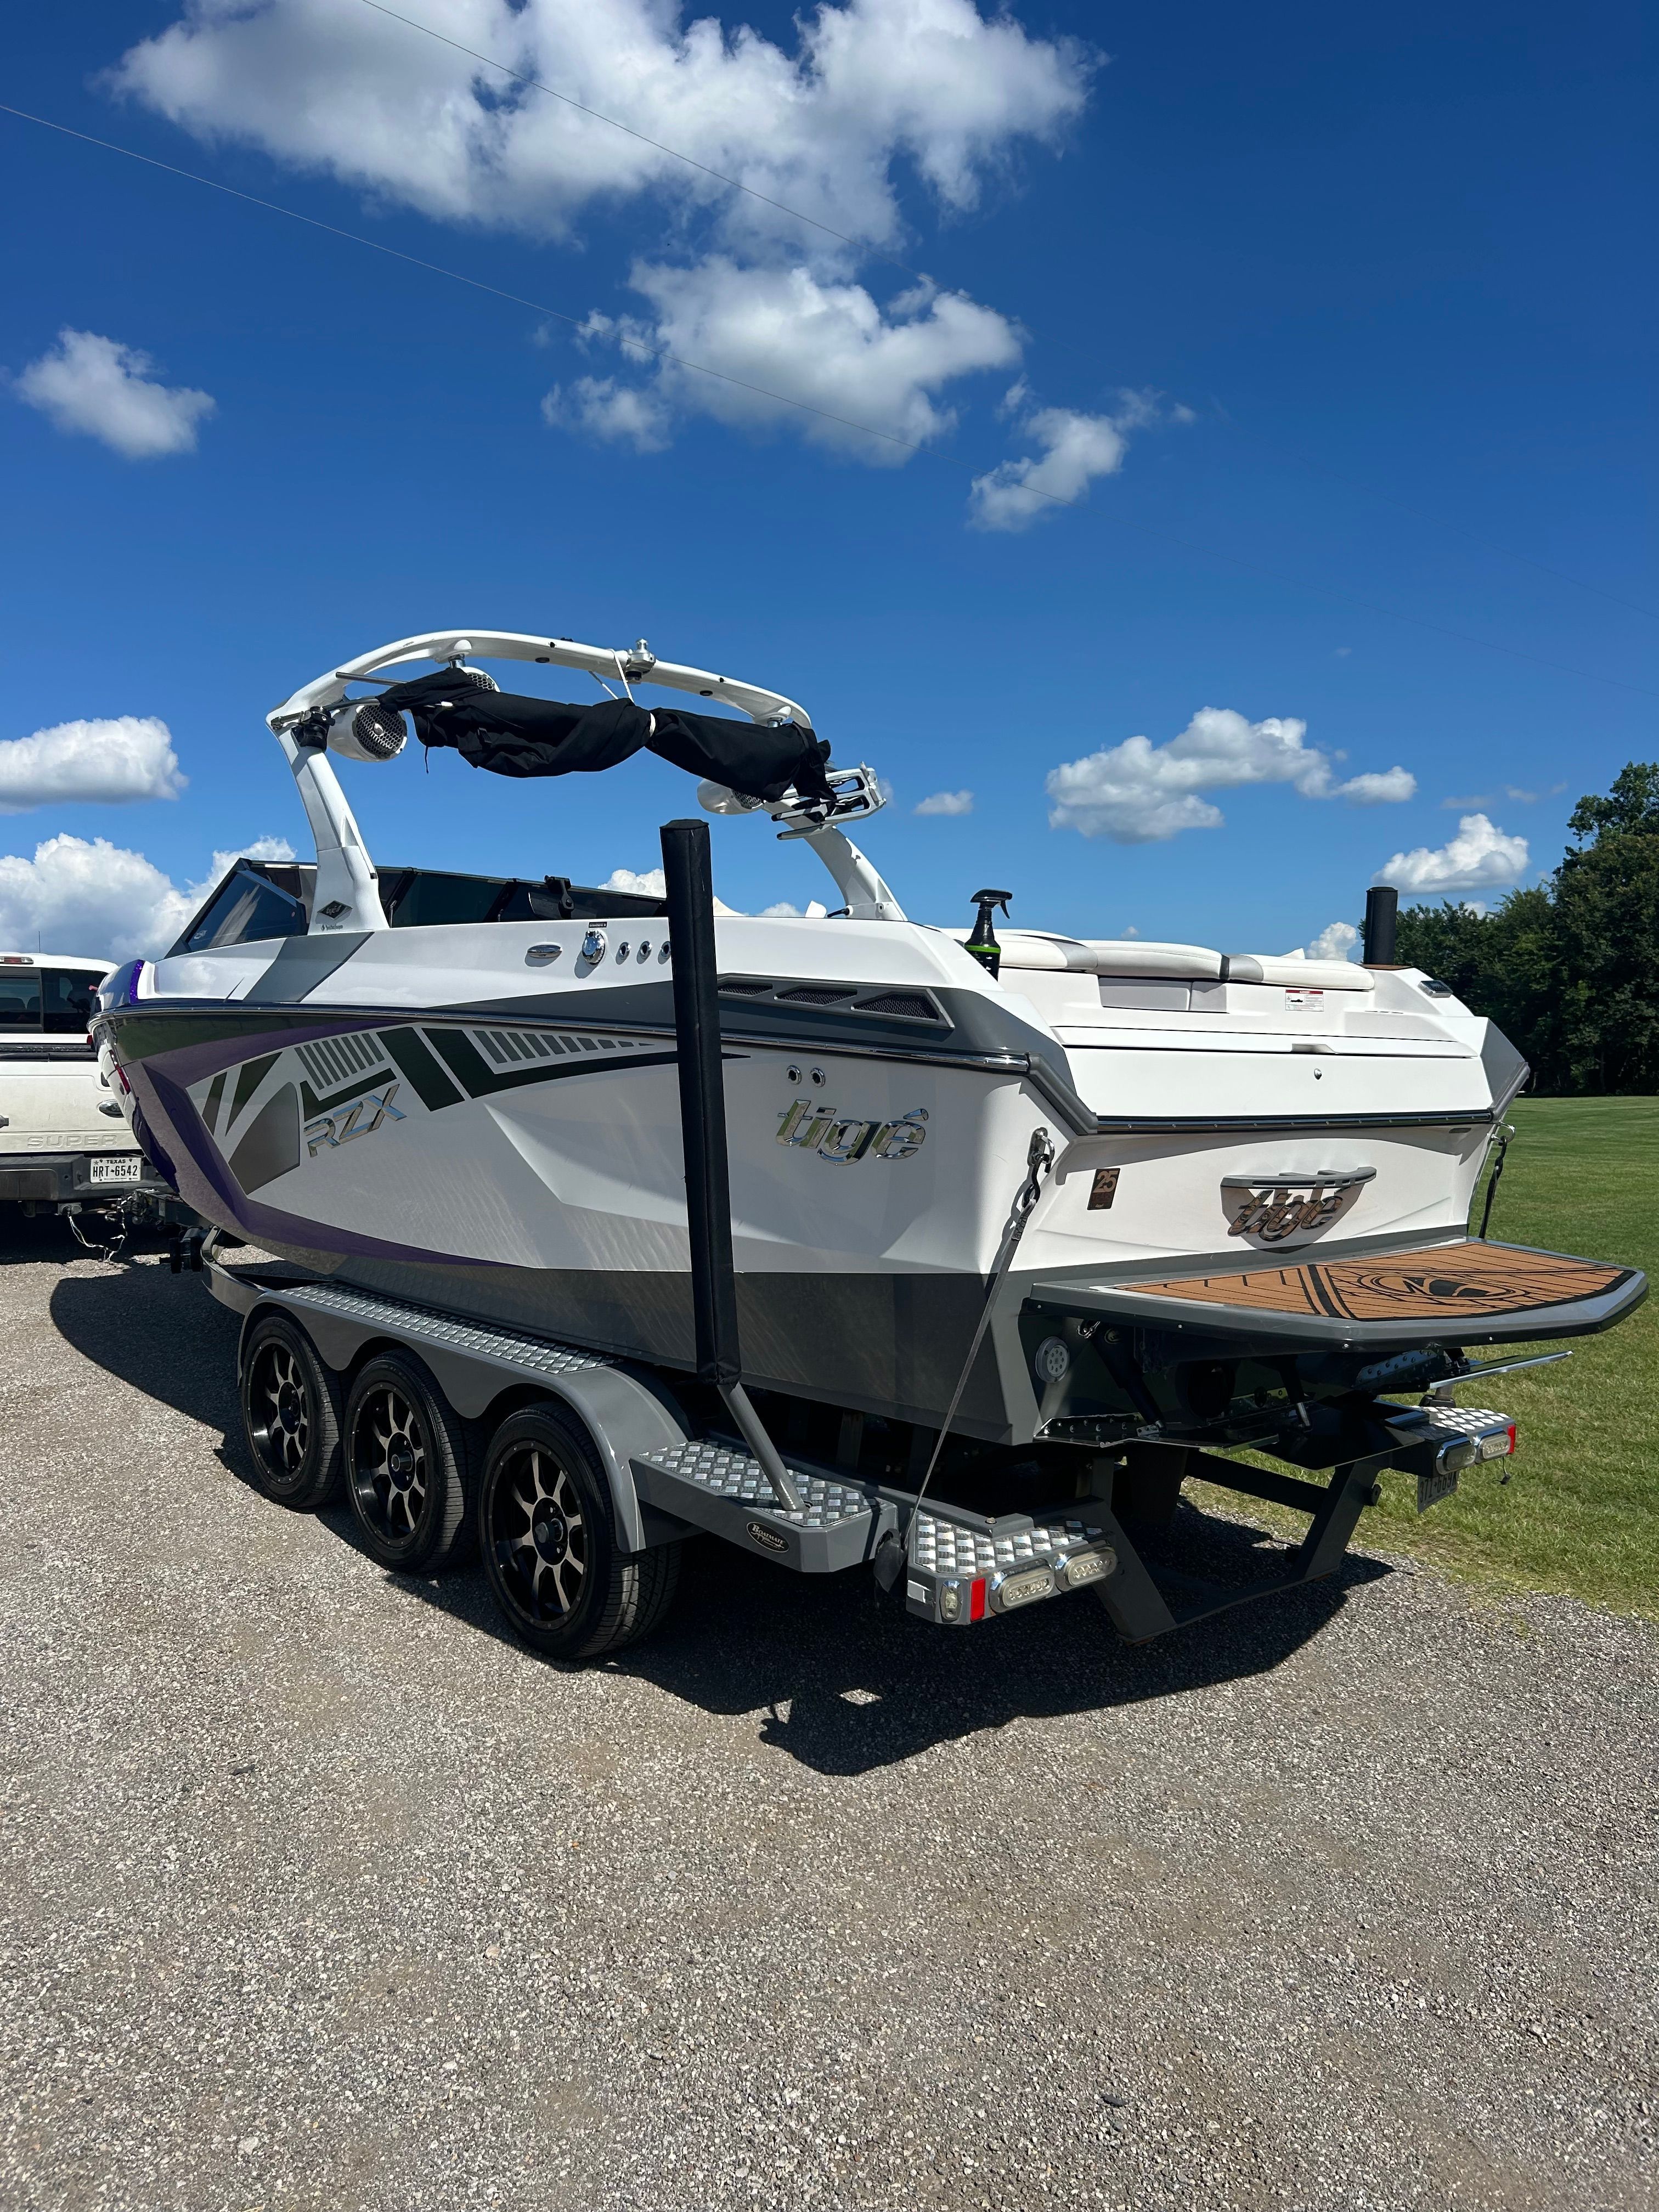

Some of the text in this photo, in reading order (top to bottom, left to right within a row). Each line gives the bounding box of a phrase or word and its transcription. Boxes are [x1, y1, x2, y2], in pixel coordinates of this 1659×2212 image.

[27, 1135, 117, 1148] SUPER
[303, 1084, 407, 1158] RZX
[776, 1099, 929, 1166] tigé
[1093, 1170, 1119, 1193] 25
